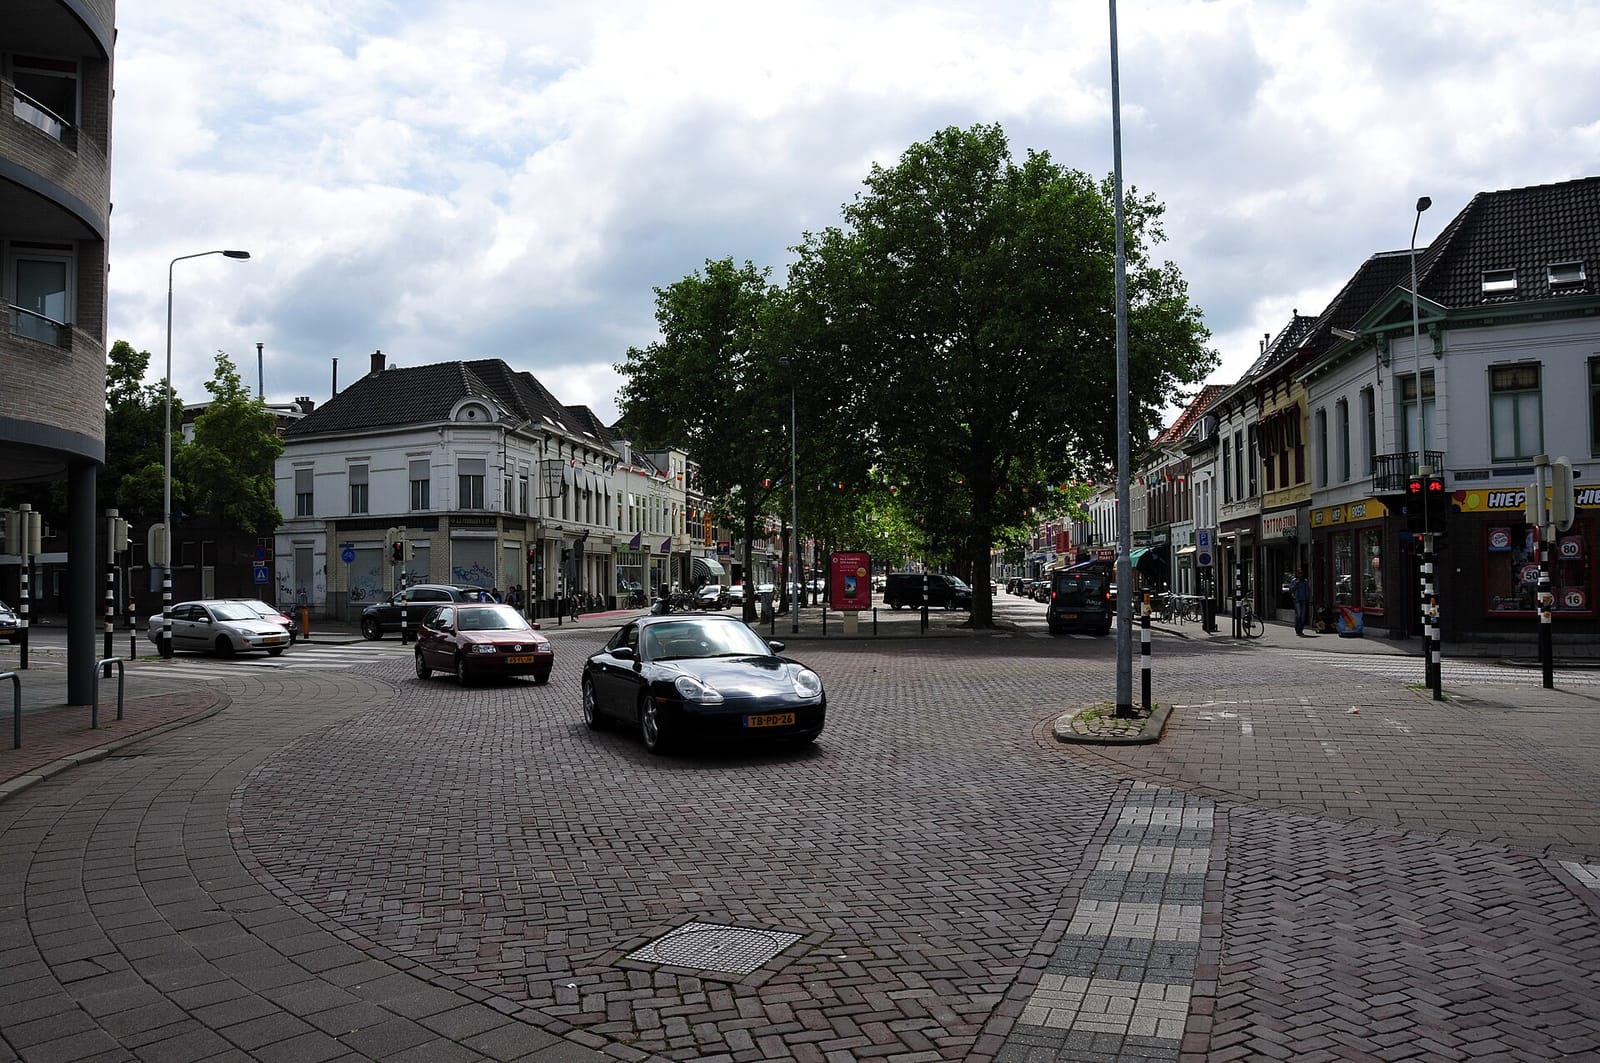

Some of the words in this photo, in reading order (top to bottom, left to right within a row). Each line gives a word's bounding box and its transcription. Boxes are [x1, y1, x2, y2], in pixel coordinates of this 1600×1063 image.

[1488, 491, 1526, 508] HIEP
[1264, 517, 1282, 534] TATTOO
[1563, 544, 1576, 554] 80
[1526, 571, 1538, 580] 50
[1567, 595, 1580, 605] 16
[751, 714, 792, 726] TB-PD-26
